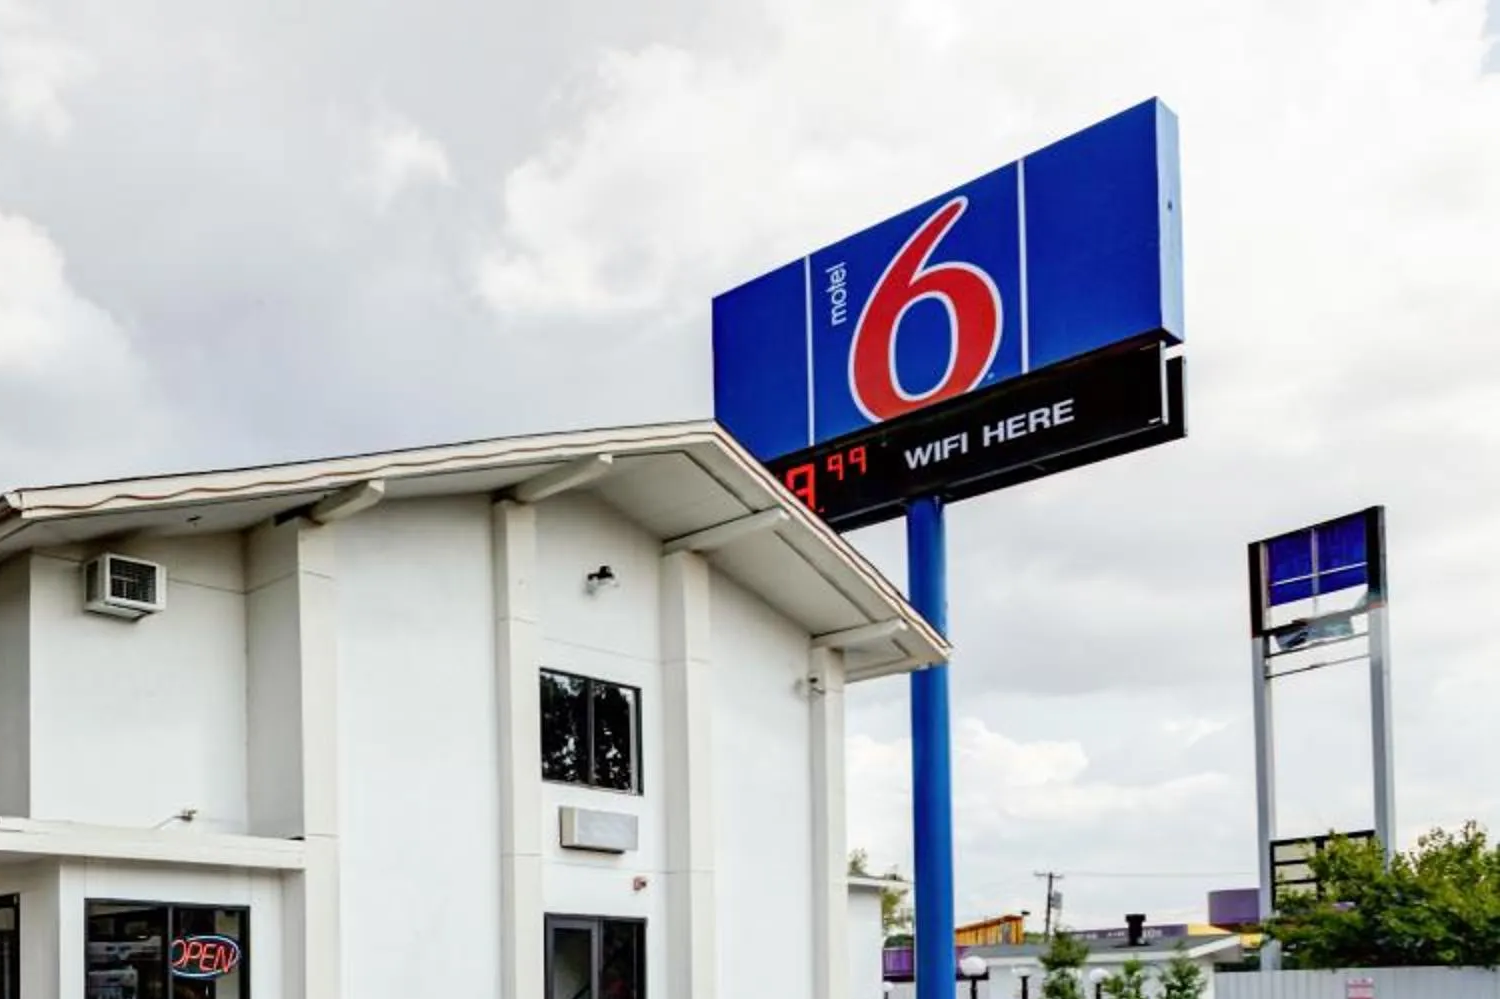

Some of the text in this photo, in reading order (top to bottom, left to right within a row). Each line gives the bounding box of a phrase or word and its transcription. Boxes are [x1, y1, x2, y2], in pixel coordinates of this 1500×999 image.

[825, 262, 847, 326] motel
[847, 195, 1002, 423] 6
[904, 398, 1075, 470] WIFI HERE
[170, 939, 235, 973] OPEN
